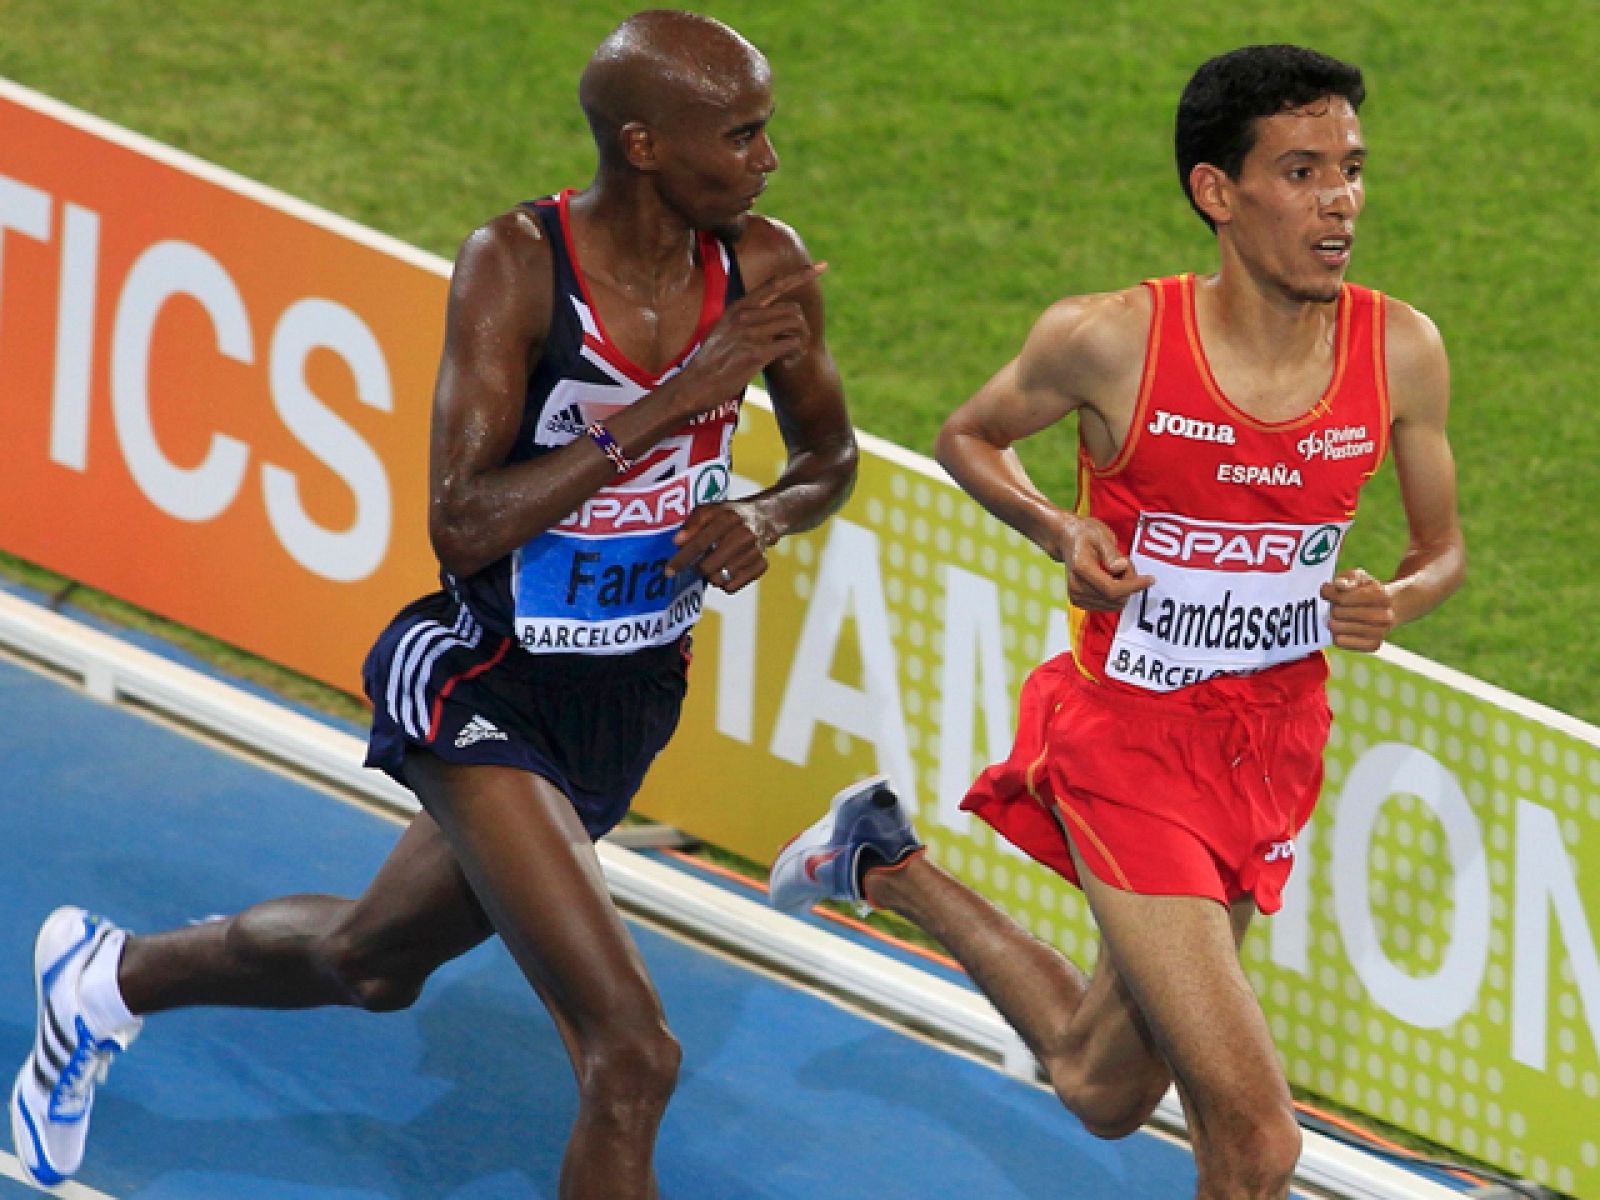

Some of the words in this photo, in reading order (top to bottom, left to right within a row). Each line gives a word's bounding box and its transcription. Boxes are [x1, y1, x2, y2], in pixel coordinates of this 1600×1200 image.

[1217, 463, 1302, 487] ESPAÑA
[560, 487, 686, 528] PAR
[1143, 523, 1297, 567] SPAR
[566, 551, 674, 607] Fara
[522, 618, 664, 648] BARCELONA
[1137, 588, 1319, 650] Lamdassem
